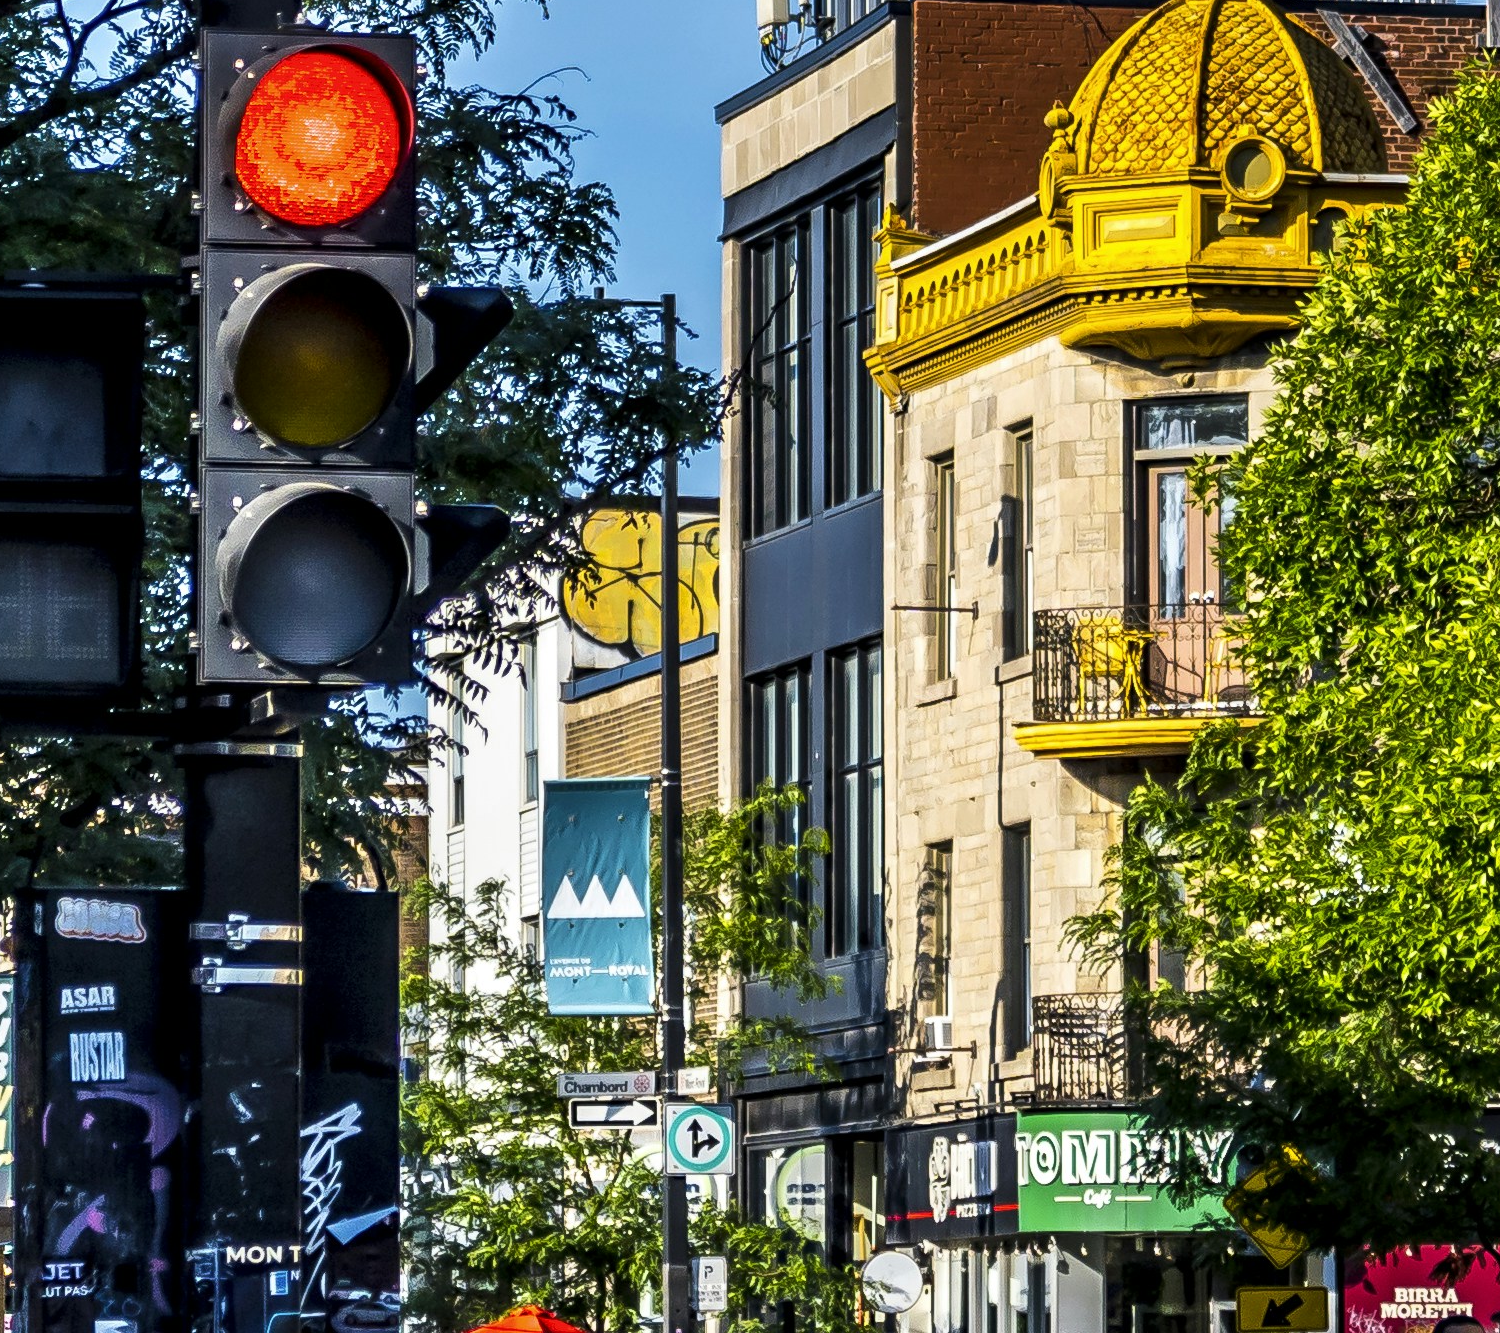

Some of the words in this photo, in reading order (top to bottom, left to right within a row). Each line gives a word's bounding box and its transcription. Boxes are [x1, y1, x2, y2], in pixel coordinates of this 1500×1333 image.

[564, 1081, 628, 1094] Chambord
[1083, 1189, 1112, 1209] Café
[1393, 1287, 1459, 1304] BIRRA
[1379, 1302, 1474, 1320] MORETTI
